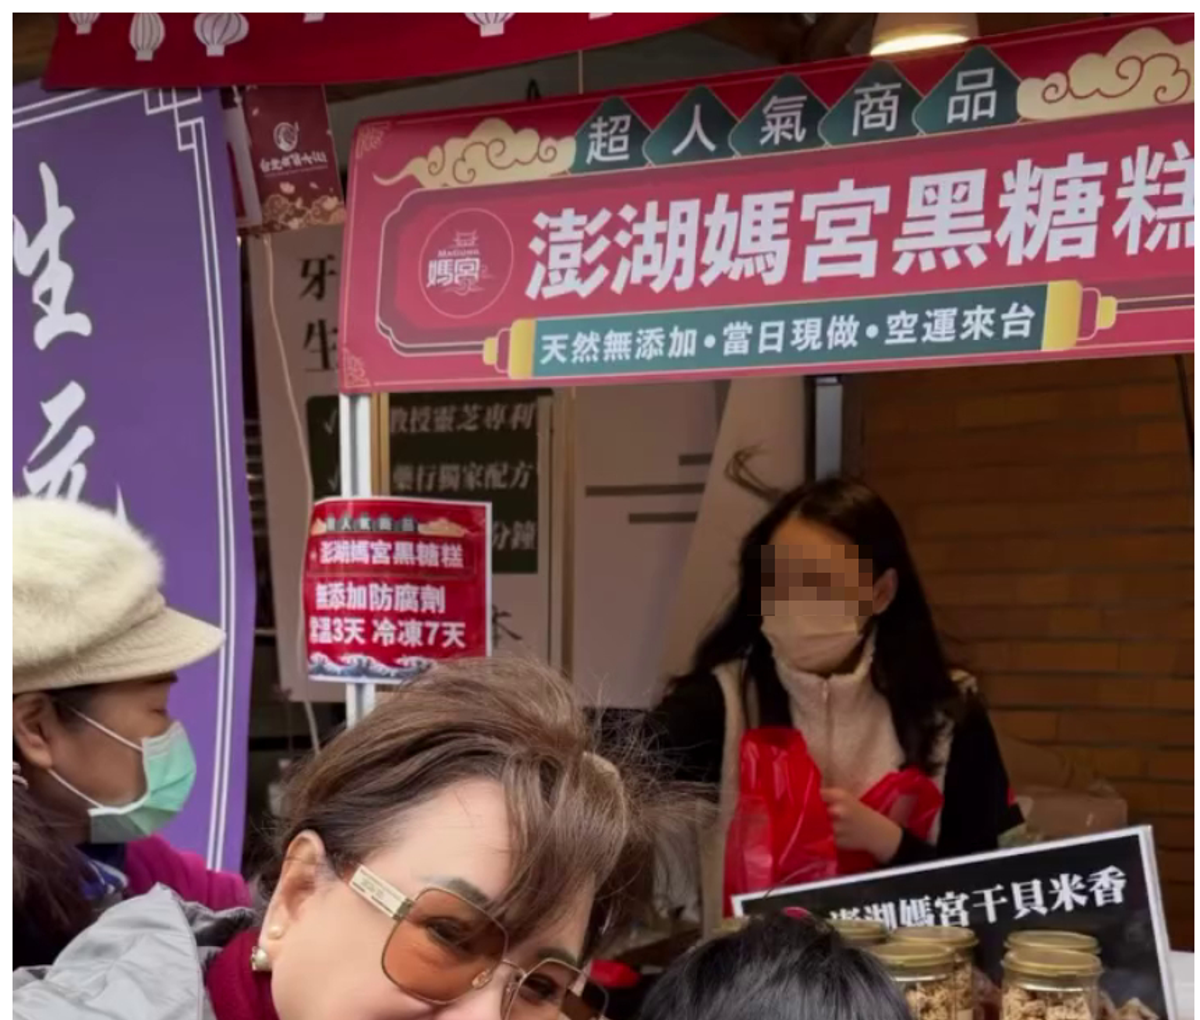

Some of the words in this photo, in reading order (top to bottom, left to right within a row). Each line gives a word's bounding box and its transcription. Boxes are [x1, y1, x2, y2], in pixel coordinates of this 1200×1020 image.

[586, 66, 998, 165] 超人氣商品
[525, 140, 1195, 301] 澎湖媽宮黑糖糕
[371, 617, 467, 649] 冷凍7天
